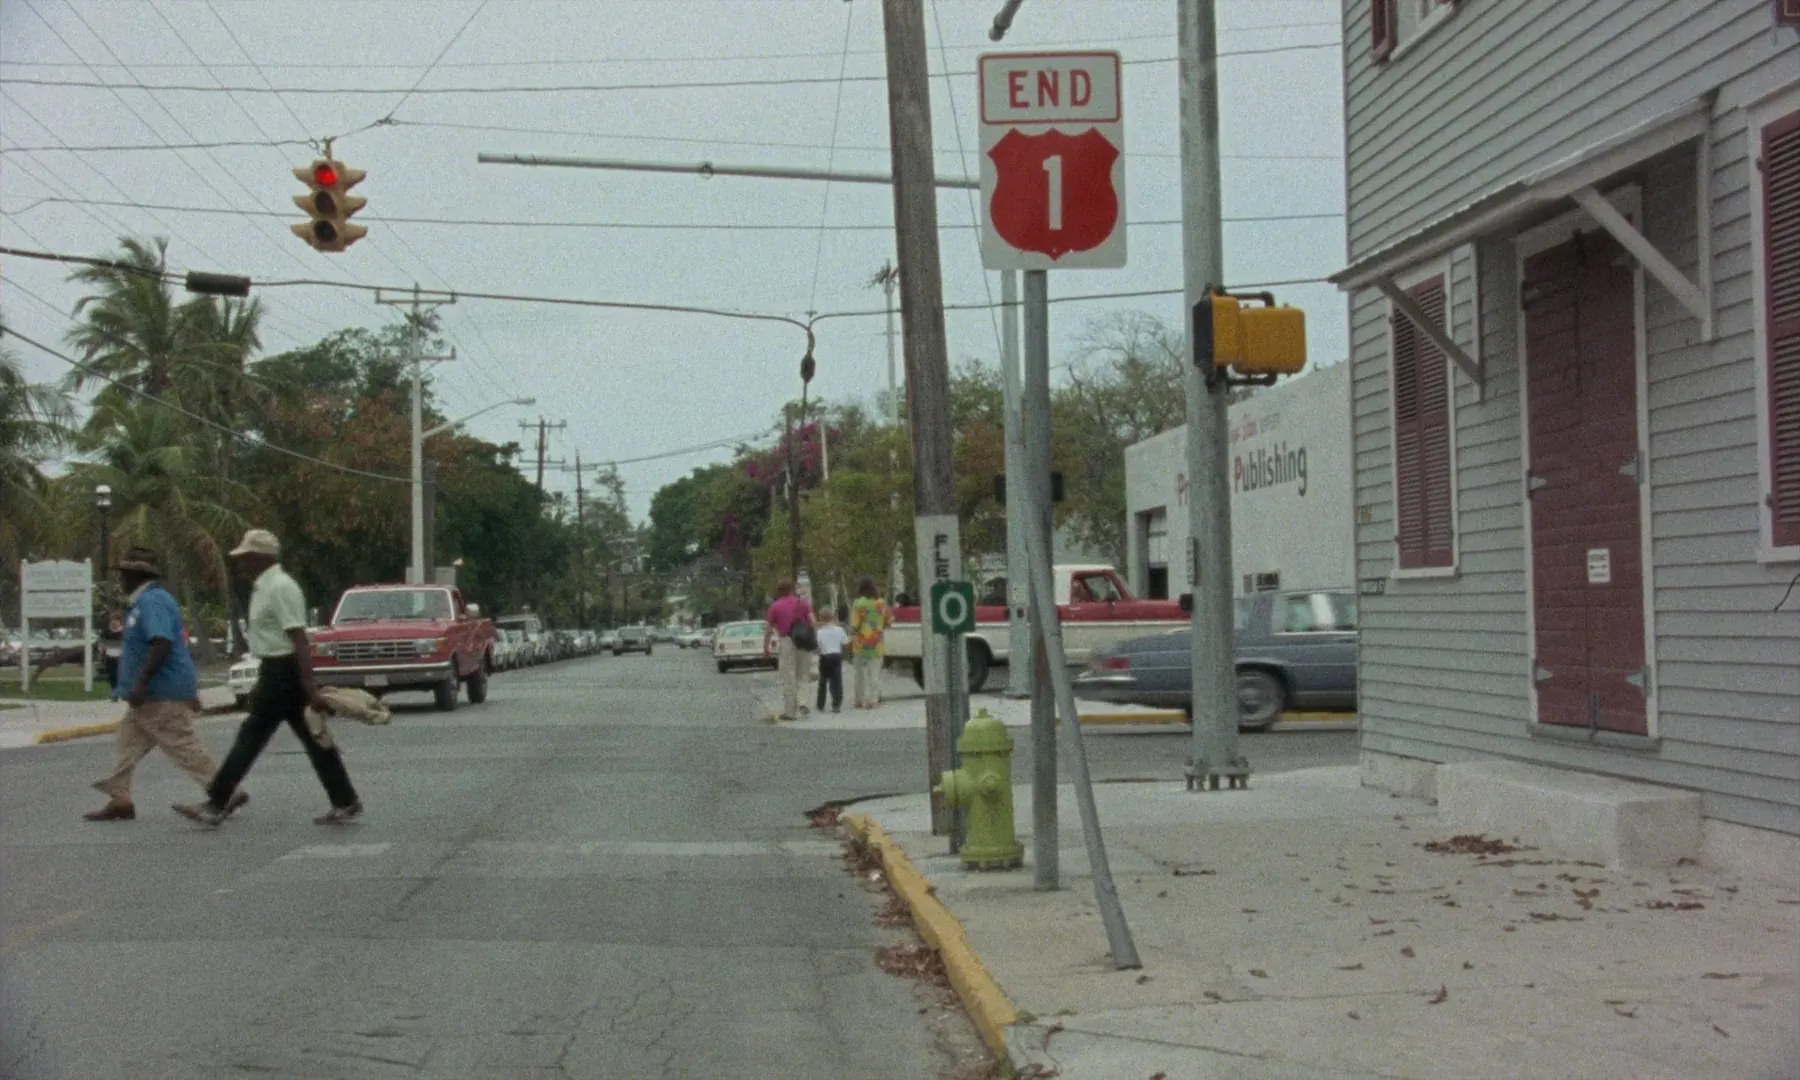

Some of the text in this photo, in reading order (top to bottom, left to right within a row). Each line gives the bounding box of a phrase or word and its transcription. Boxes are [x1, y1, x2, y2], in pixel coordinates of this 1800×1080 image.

[1008, 69, 1092, 108] END
[1042, 154, 1063, 230] 1
[1234, 440, 1307, 497] Publishing
[934, 534, 950, 583] FLE
